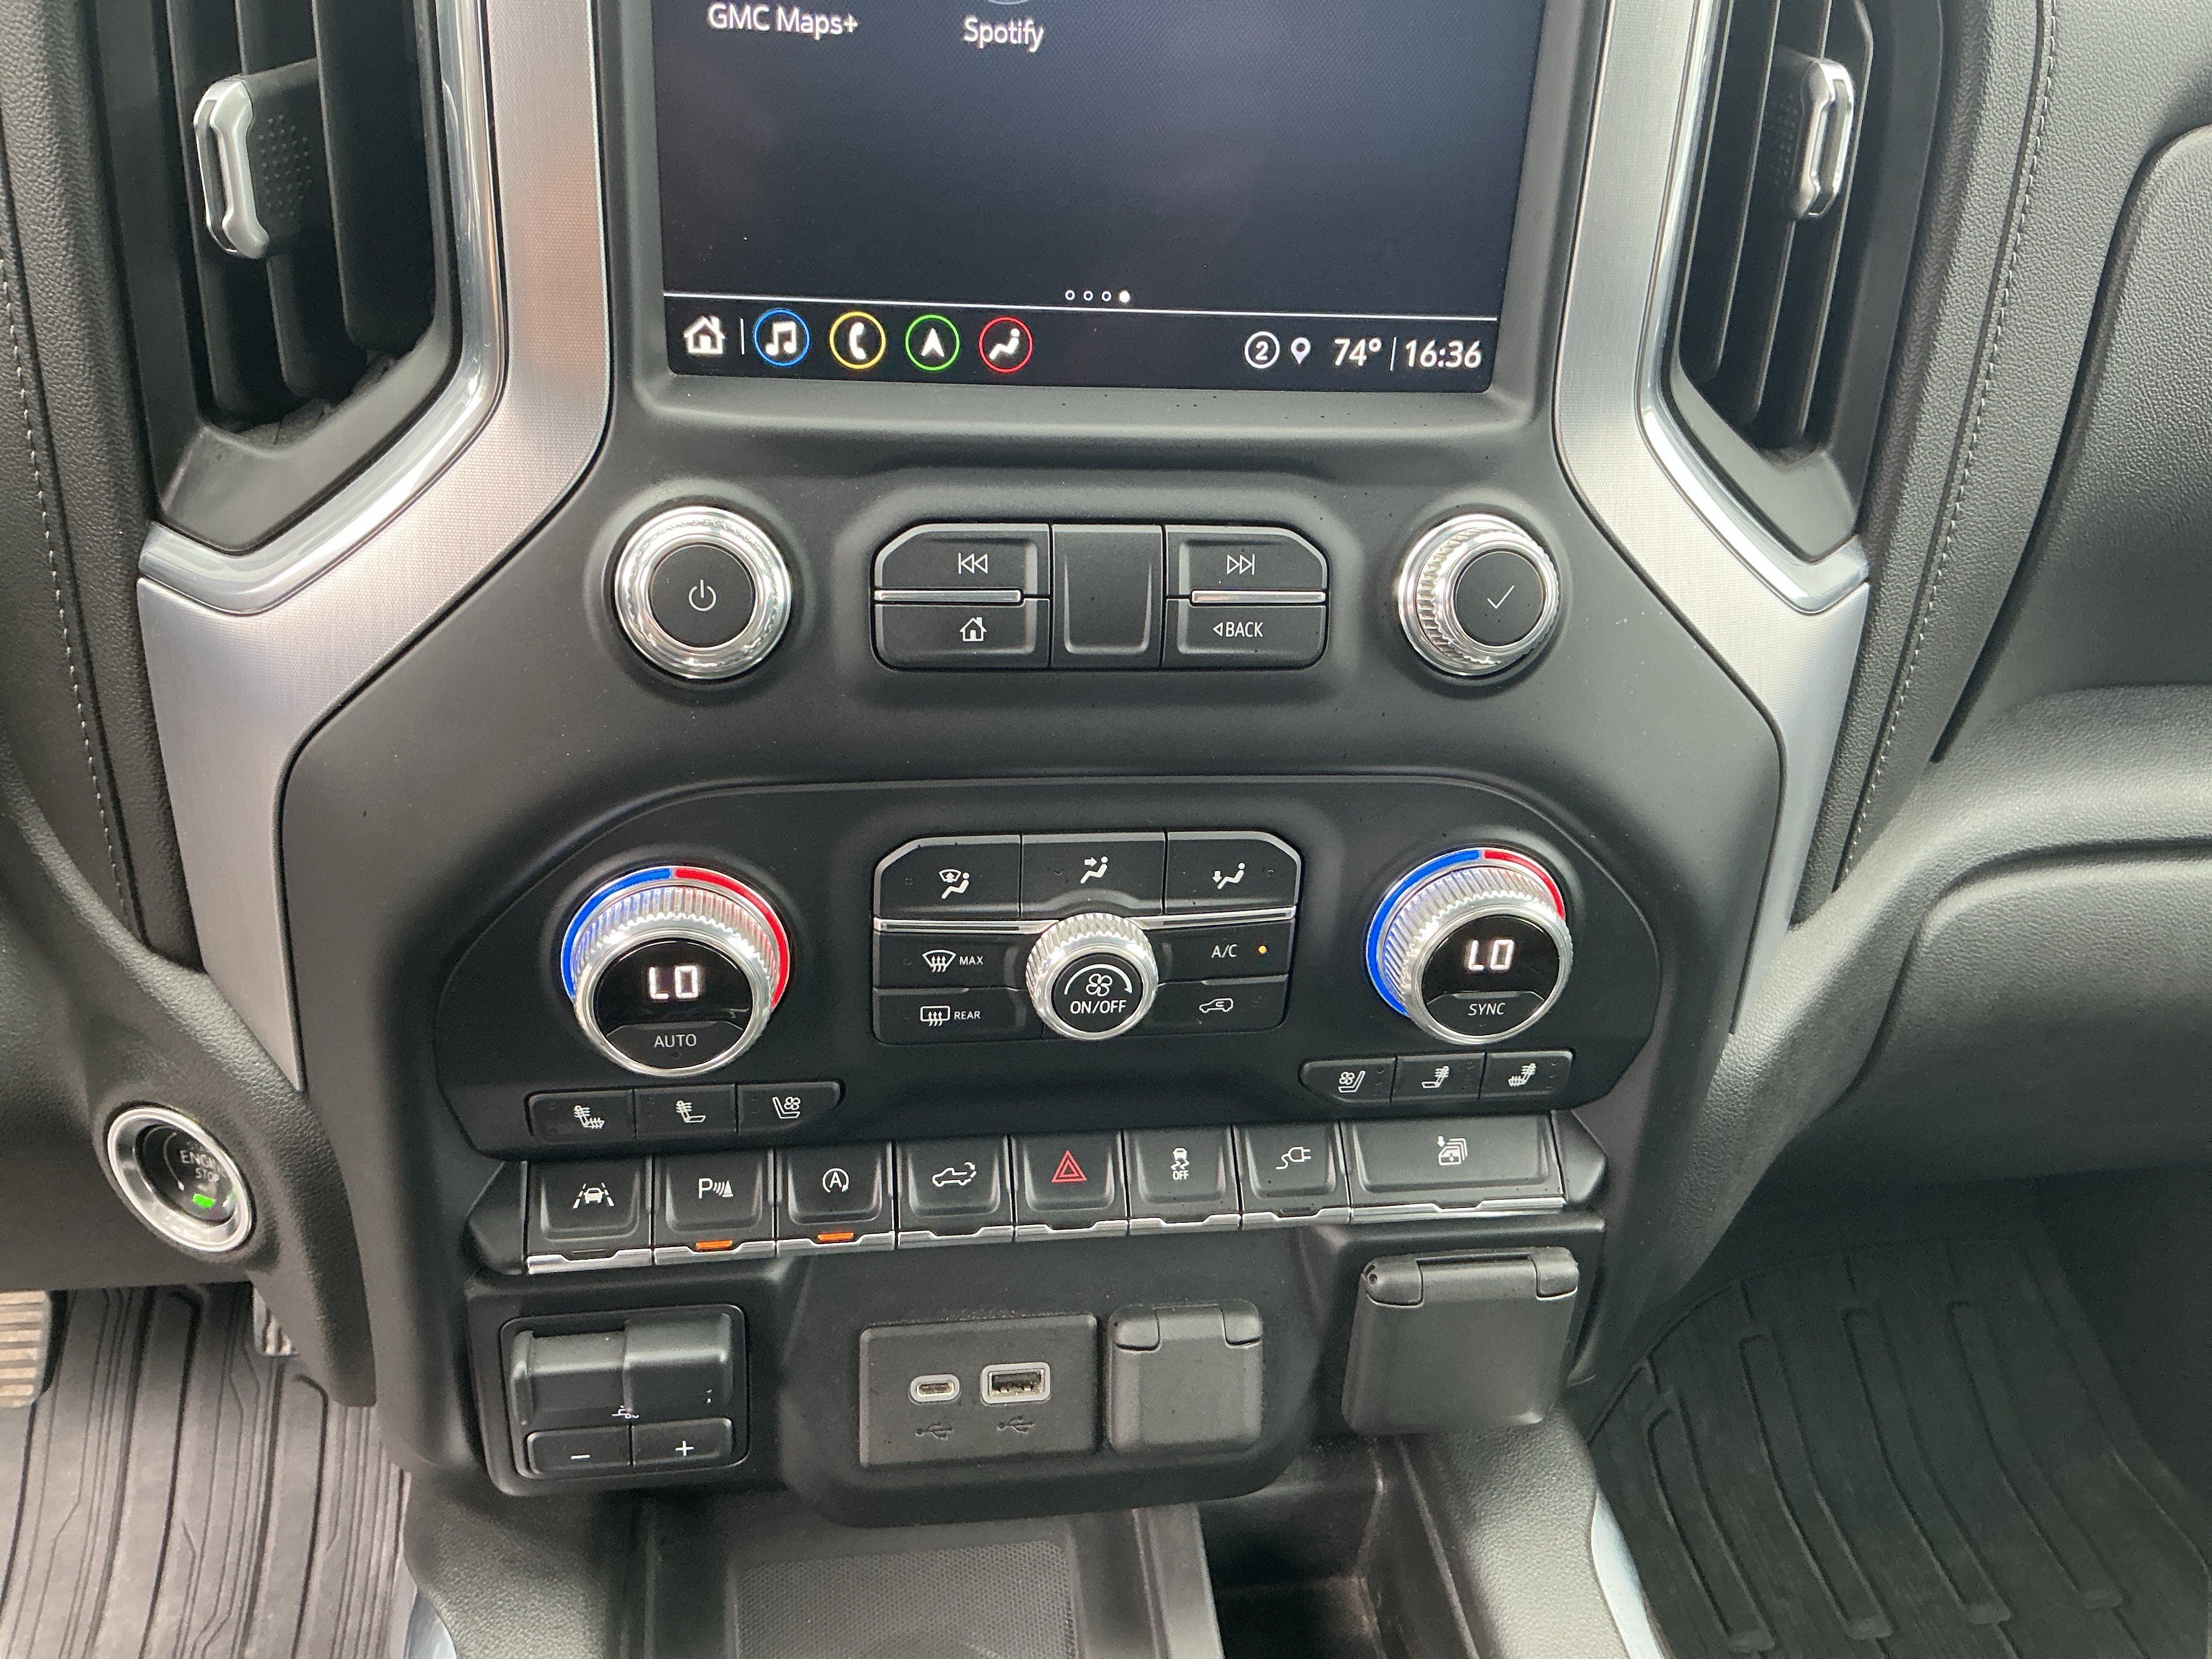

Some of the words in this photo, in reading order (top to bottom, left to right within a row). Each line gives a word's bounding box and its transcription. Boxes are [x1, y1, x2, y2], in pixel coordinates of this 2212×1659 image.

[707, 2, 771, 32] GMC
[775, 4, 859, 41] Maps+
[962, 15, 1045, 53] Spotify
[1255, 341, 1269, 361] 2
[1405, 340, 1482, 369] 16:36
[1226, 621, 1263, 638] BACK
[1211, 943, 1238, 959] A/C
[958, 955, 984, 966] MAX
[953, 1010, 981, 1020] REAR
[1069, 999, 1127, 1015] ON/OFF
[1467, 1002, 1506, 1016] SYNC
[653, 1034, 697, 1048] AUTO
[829, 1171, 841, 1188] A
[1172, 1170, 1189, 1181] OFF
[698, 1178, 713, 1199] P
